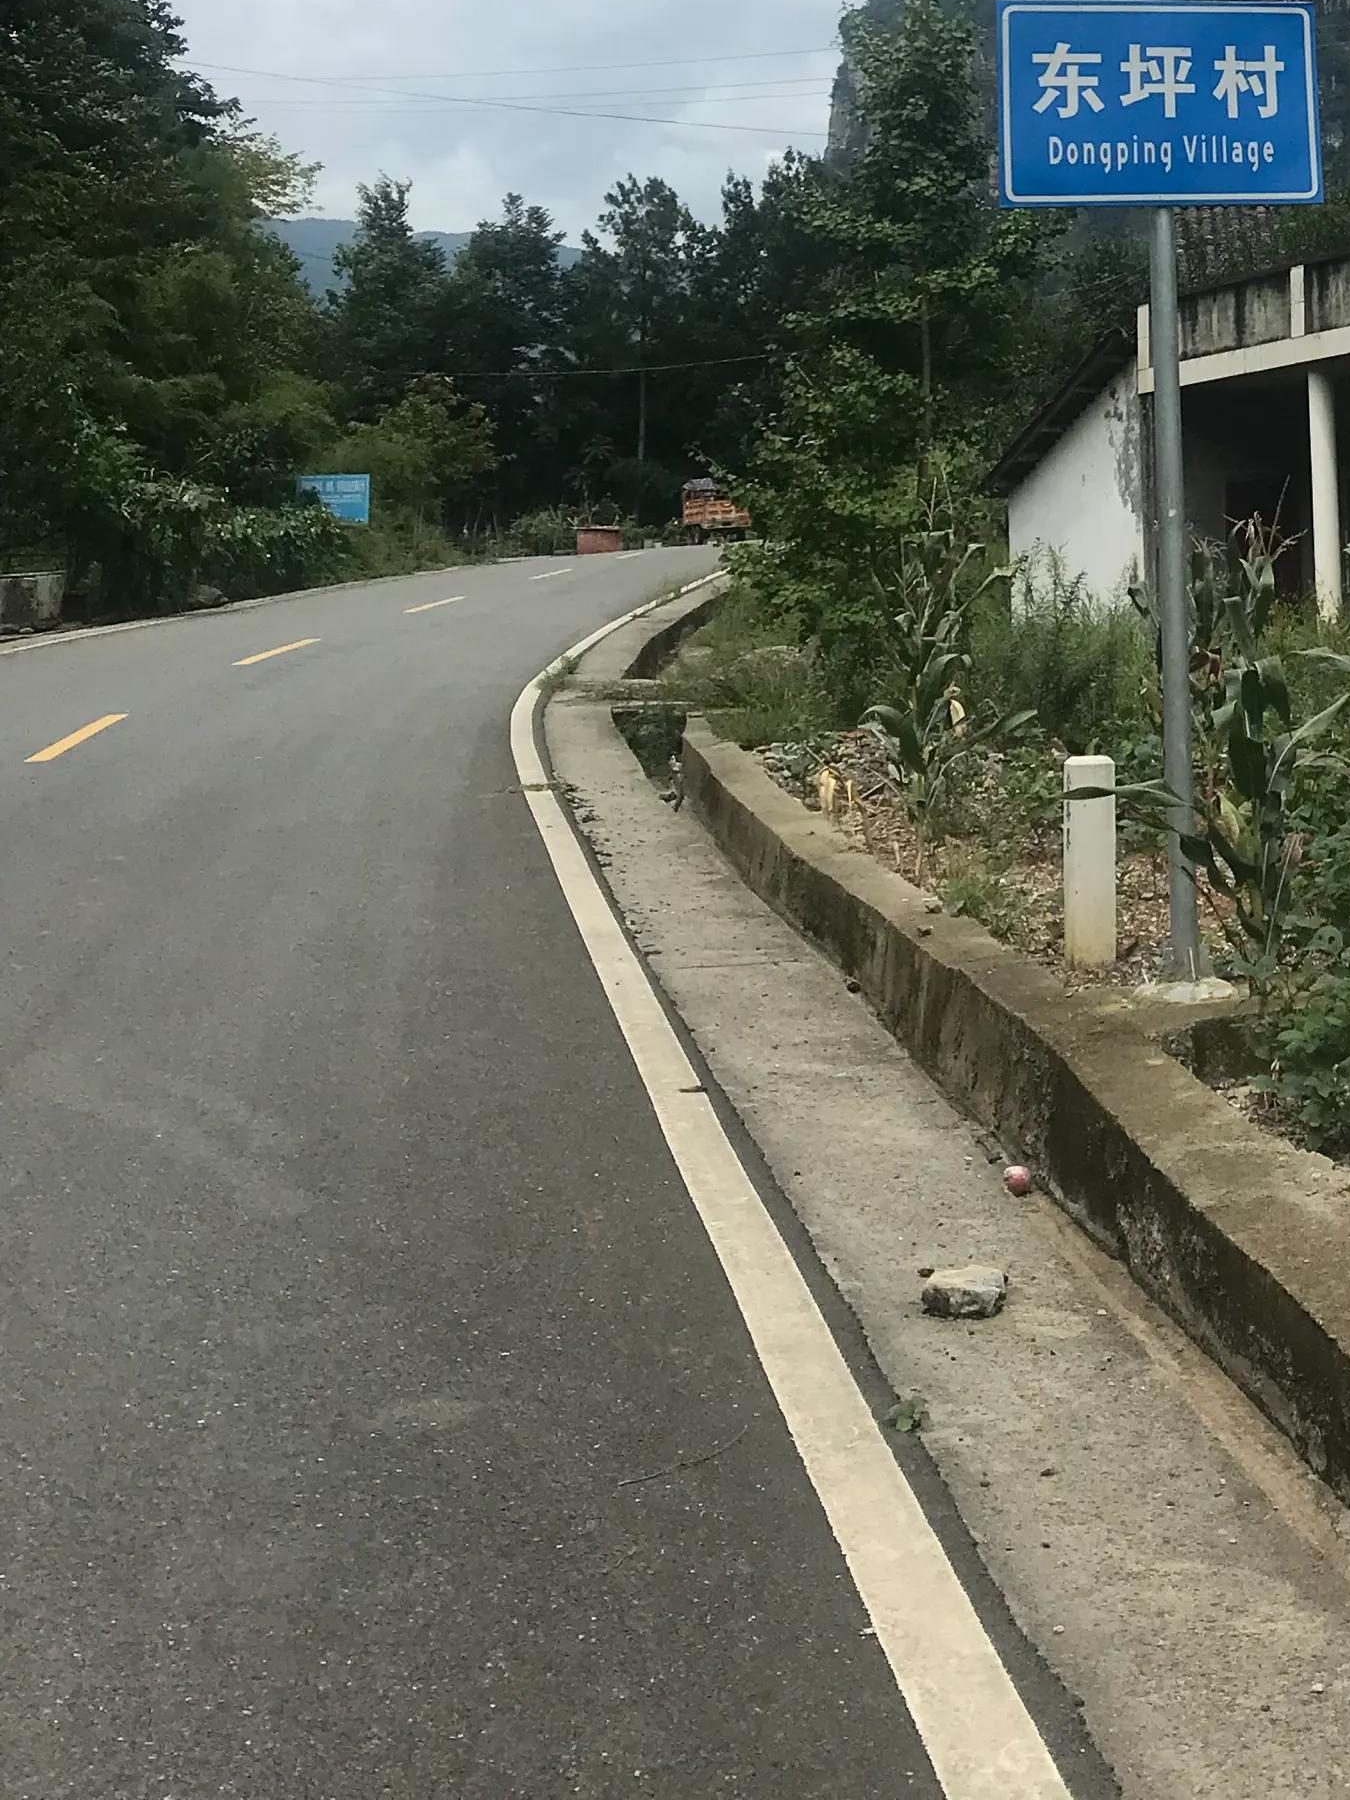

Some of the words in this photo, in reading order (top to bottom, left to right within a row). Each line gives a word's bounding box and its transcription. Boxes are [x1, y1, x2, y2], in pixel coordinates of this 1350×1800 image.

[1031, 41, 1285, 119] 东坪村
[1048, 135, 1172, 173] Dongping
[1182, 134, 1275, 172] Village
